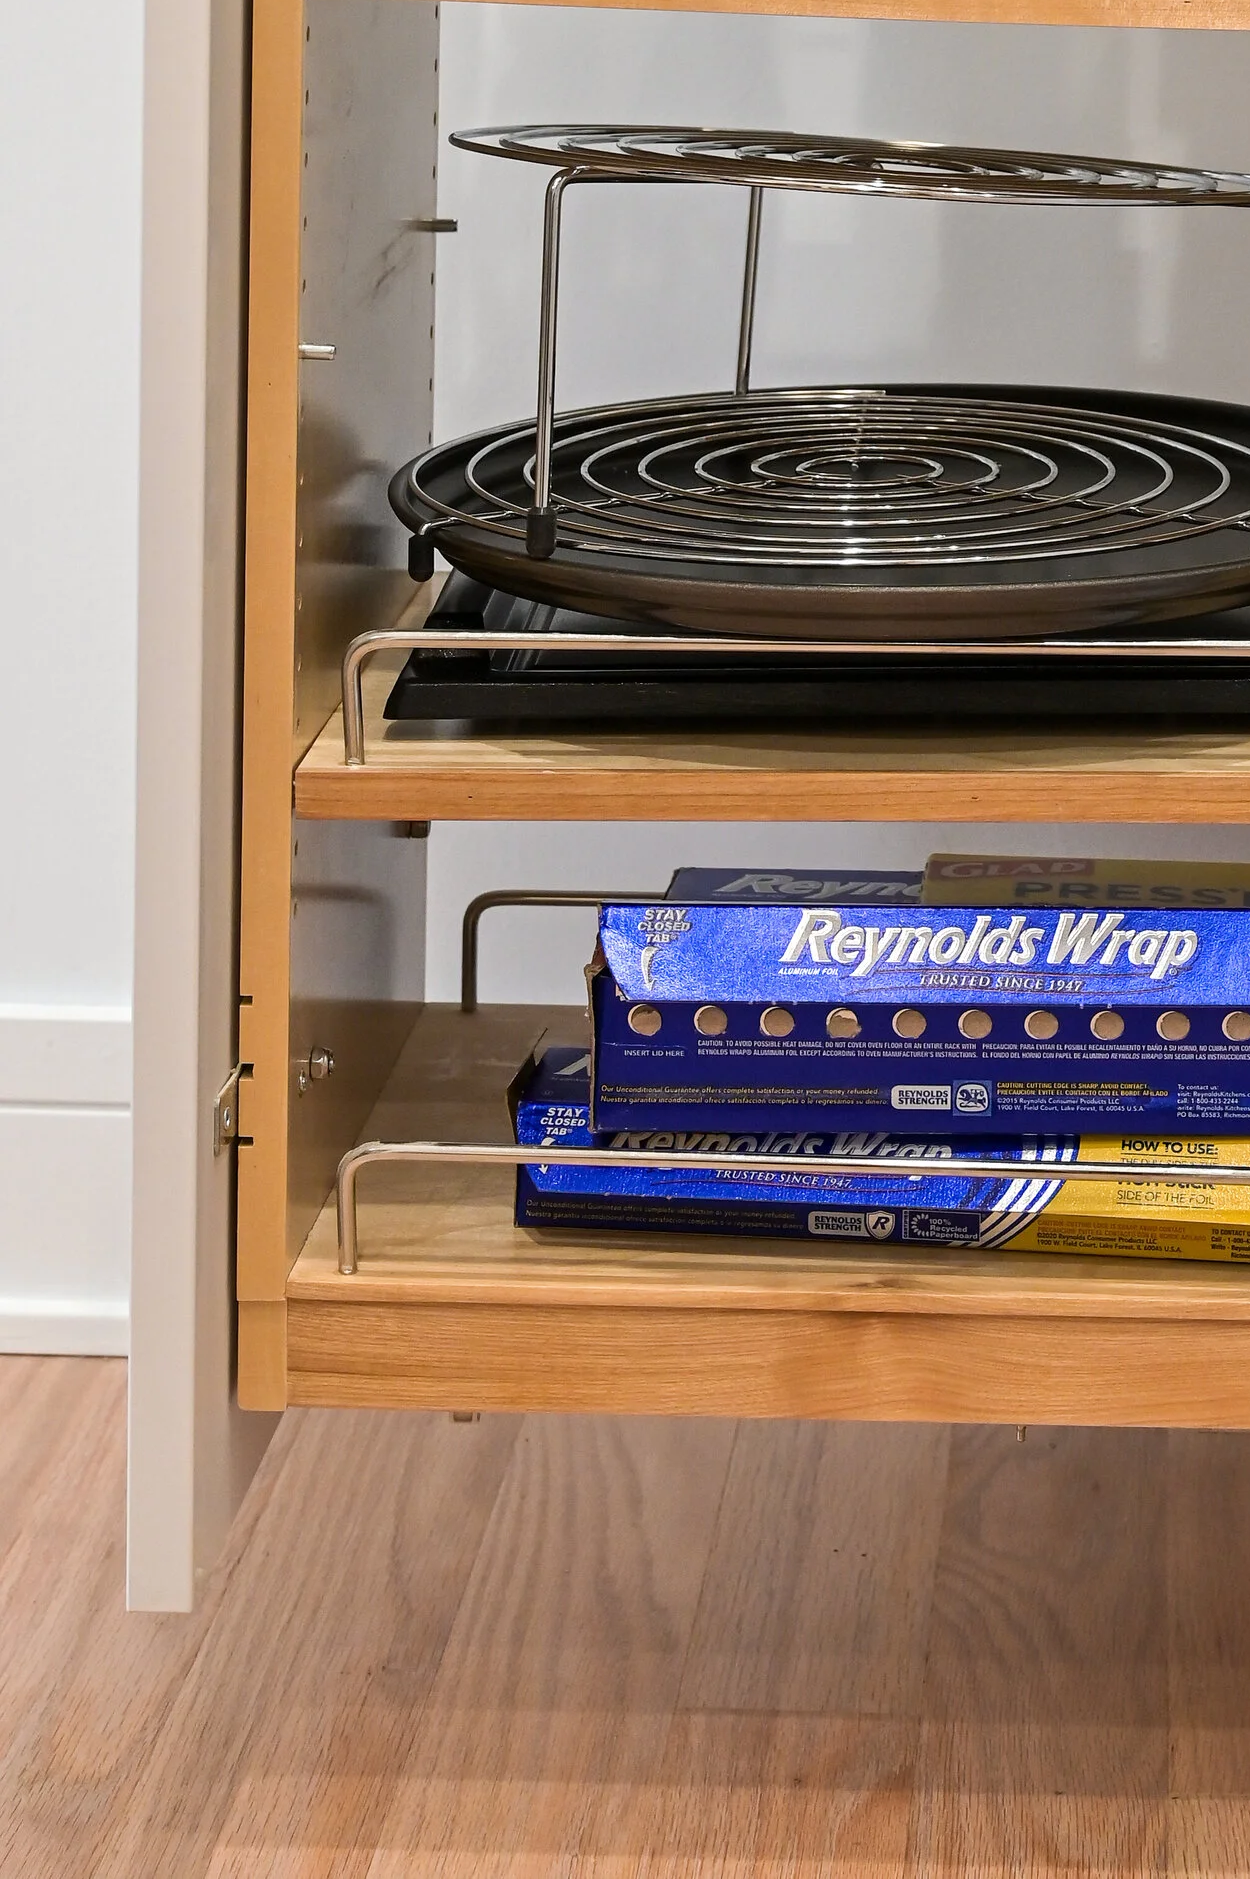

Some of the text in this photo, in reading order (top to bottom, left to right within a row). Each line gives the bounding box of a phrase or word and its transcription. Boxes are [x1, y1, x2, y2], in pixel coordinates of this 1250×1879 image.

[940, 861, 1087, 878] GLAD
[713, 872, 922, 899] Reyno
[644, 908, 688, 921] STAY
[637, 921, 692, 933] CLOSED
[777, 908, 1199, 980] Reynolds Wrap
[777, 968, 839, 976] ALUMINUM FOIL
[919, 973, 1085, 993] TRUSTED SINCE 1947
[624, 1049, 650, 1057] INSERT
[898, 1089, 949, 1098] REYNOLDS
[897, 1097, 949, 1106] STRENGTH
[546, 1107, 584, 1118] STAY
[539, 1117, 587, 1127] CLOSED
[1121, 1139, 1219, 1156] HOW TO USE:
[714, 1168, 852, 1188] TRUSTED SINCE 1947
[1116, 1189, 1215, 1206] SIDE OF THE FOIL
[814, 1215, 862, 1225] REYNOLDS
[872, 1216, 890, 1231] R
[814, 1223, 862, 1232] STRENGTH
[929, 1225, 968, 1233] Recycled
[929, 1231, 978, 1240] Paperboard
